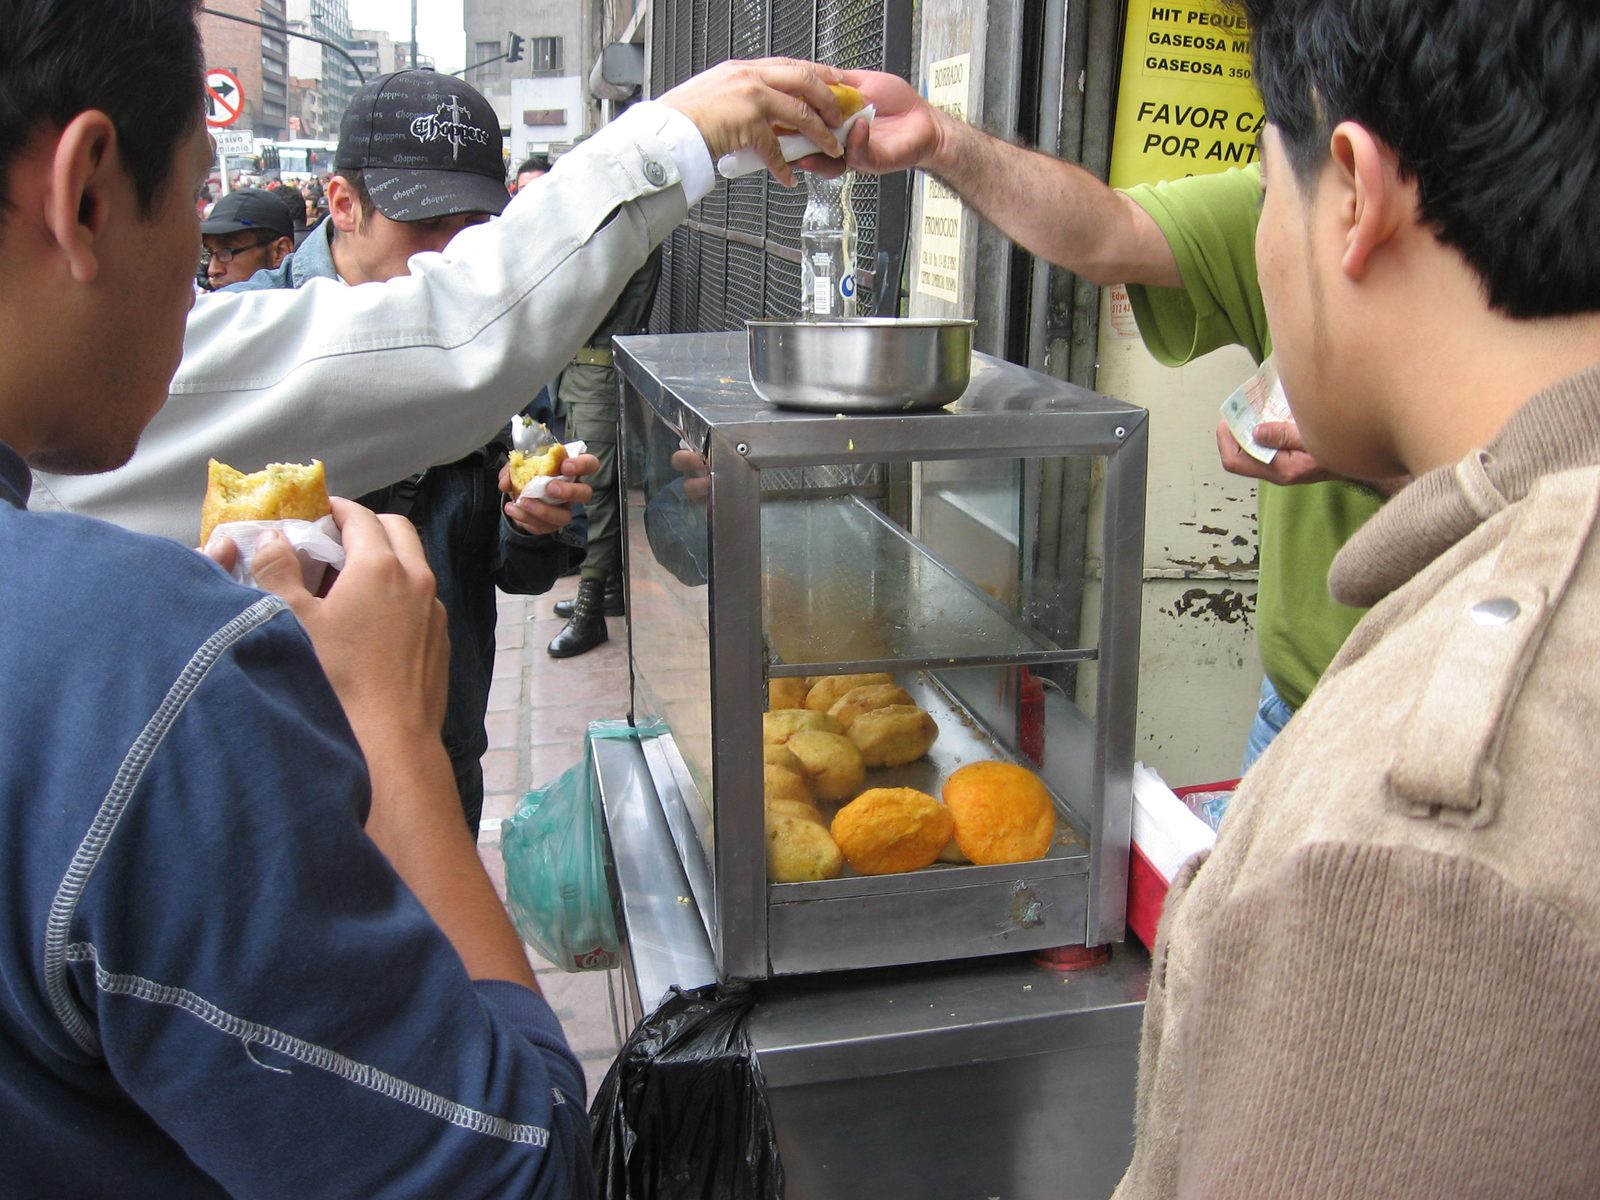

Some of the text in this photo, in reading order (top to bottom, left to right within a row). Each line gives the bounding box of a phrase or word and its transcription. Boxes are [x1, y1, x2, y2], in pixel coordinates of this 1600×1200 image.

[1151, 7, 1182, 22] HIT
[1148, 32, 1226, 52] GASEOSA
[934, 63, 964, 89] BORRADO
[1146, 57, 1224, 76] GASEOSA
[1137, 102, 1229, 130] FAVOR
[410, 114, 489, 147] Choppers
[1142, 134, 1257, 164] POR ANT
[924, 216, 959, 239] PROMOCION
